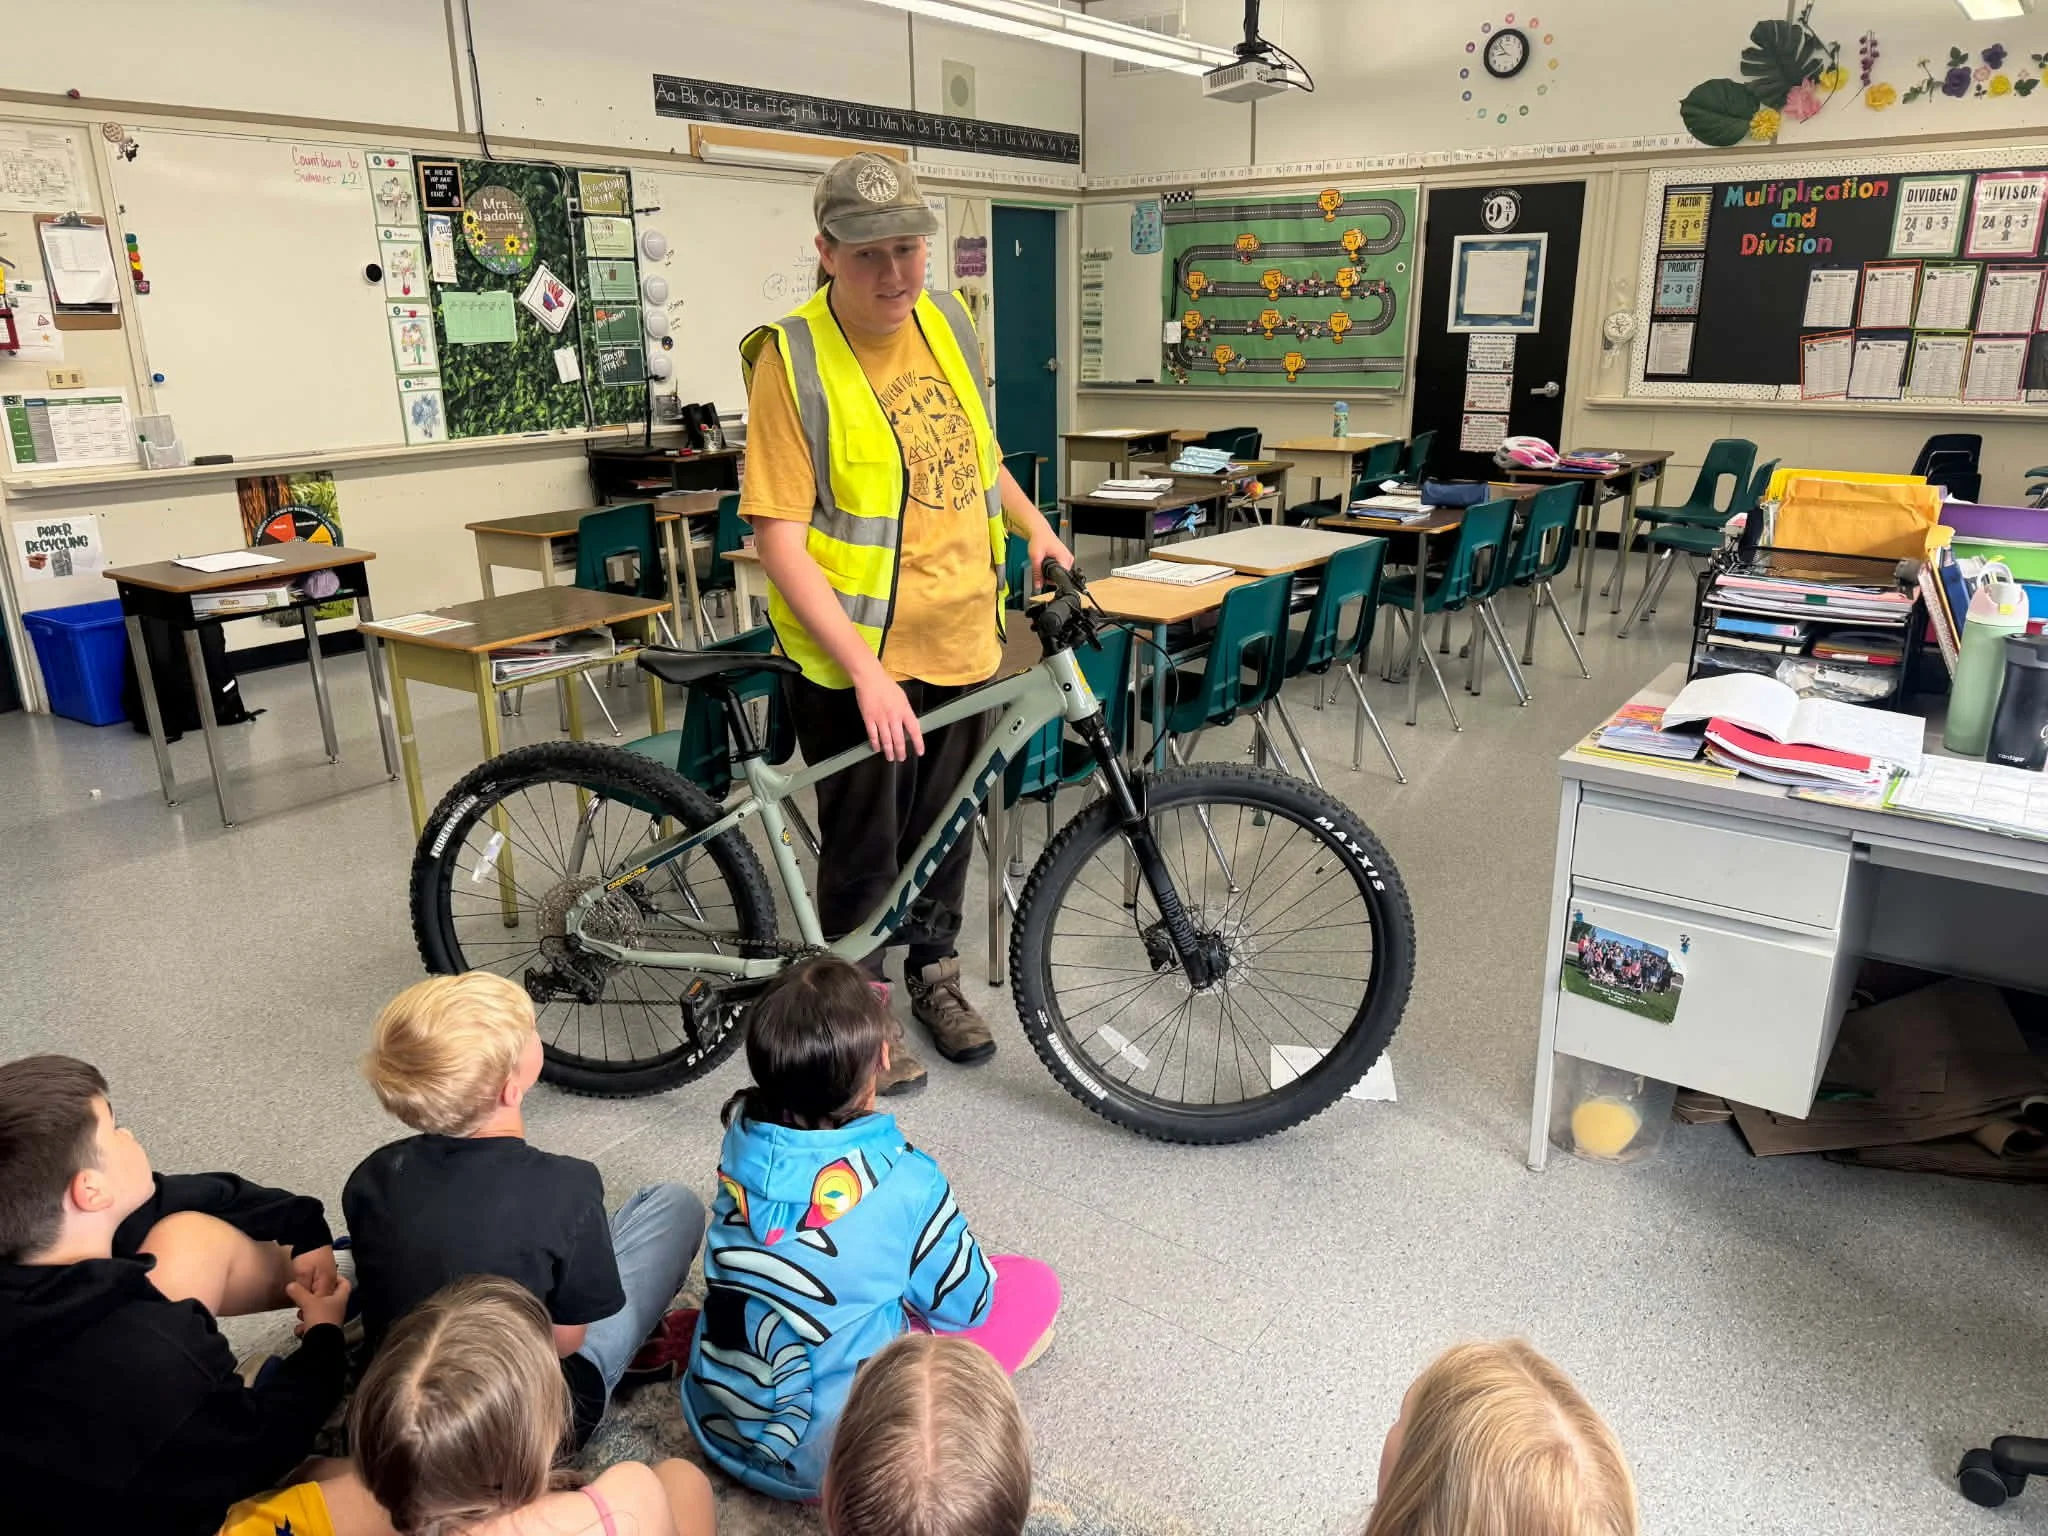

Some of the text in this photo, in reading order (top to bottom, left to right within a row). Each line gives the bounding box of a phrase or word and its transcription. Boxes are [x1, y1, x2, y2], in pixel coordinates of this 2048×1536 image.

[656, 83, 675, 101] Aa
[680, 86, 698, 104] Bb
[704, 89, 720, 107] Cc
[722, 92, 740, 110] Dd
[746, 95, 759, 112] Ee
[766, 97, 777, 113] Ff
[780, 100, 797, 123] Gg
[802, 104, 816, 120] Hh
[831, 107, 840, 129] Jj
[848, 108, 860, 125] Kk
[867, 111, 876, 128] Ll
[880, 114, 898, 131] Mm
[902, 117, 914, 132] Nn
[918, 119, 929, 134] Oo
[935, 119, 945, 144] Pp
[949, 123, 962, 144] Qq
[966, 126, 975, 140] Rr
[1723, 176, 1889, 210] Multiplication
[1906, 187, 1958, 203] DIVIDEND
[482, 198, 512, 210] Mrs.
[1676, 196, 1700, 208] FACTOR
[1771, 206, 1818, 228] and
[1904, 216, 1917, 231] 24
[1982, 215, 1996, 230] 24
[1740, 232, 1833, 256] Division
[1667, 261, 1697, 273] PRODUCT
[37, 523, 72, 538] PAPER
[25, 535, 88, 554] RECYCLING
[870, 747, 1008, 937] KONA
[1313, 816, 1385, 891] MAXXIS
